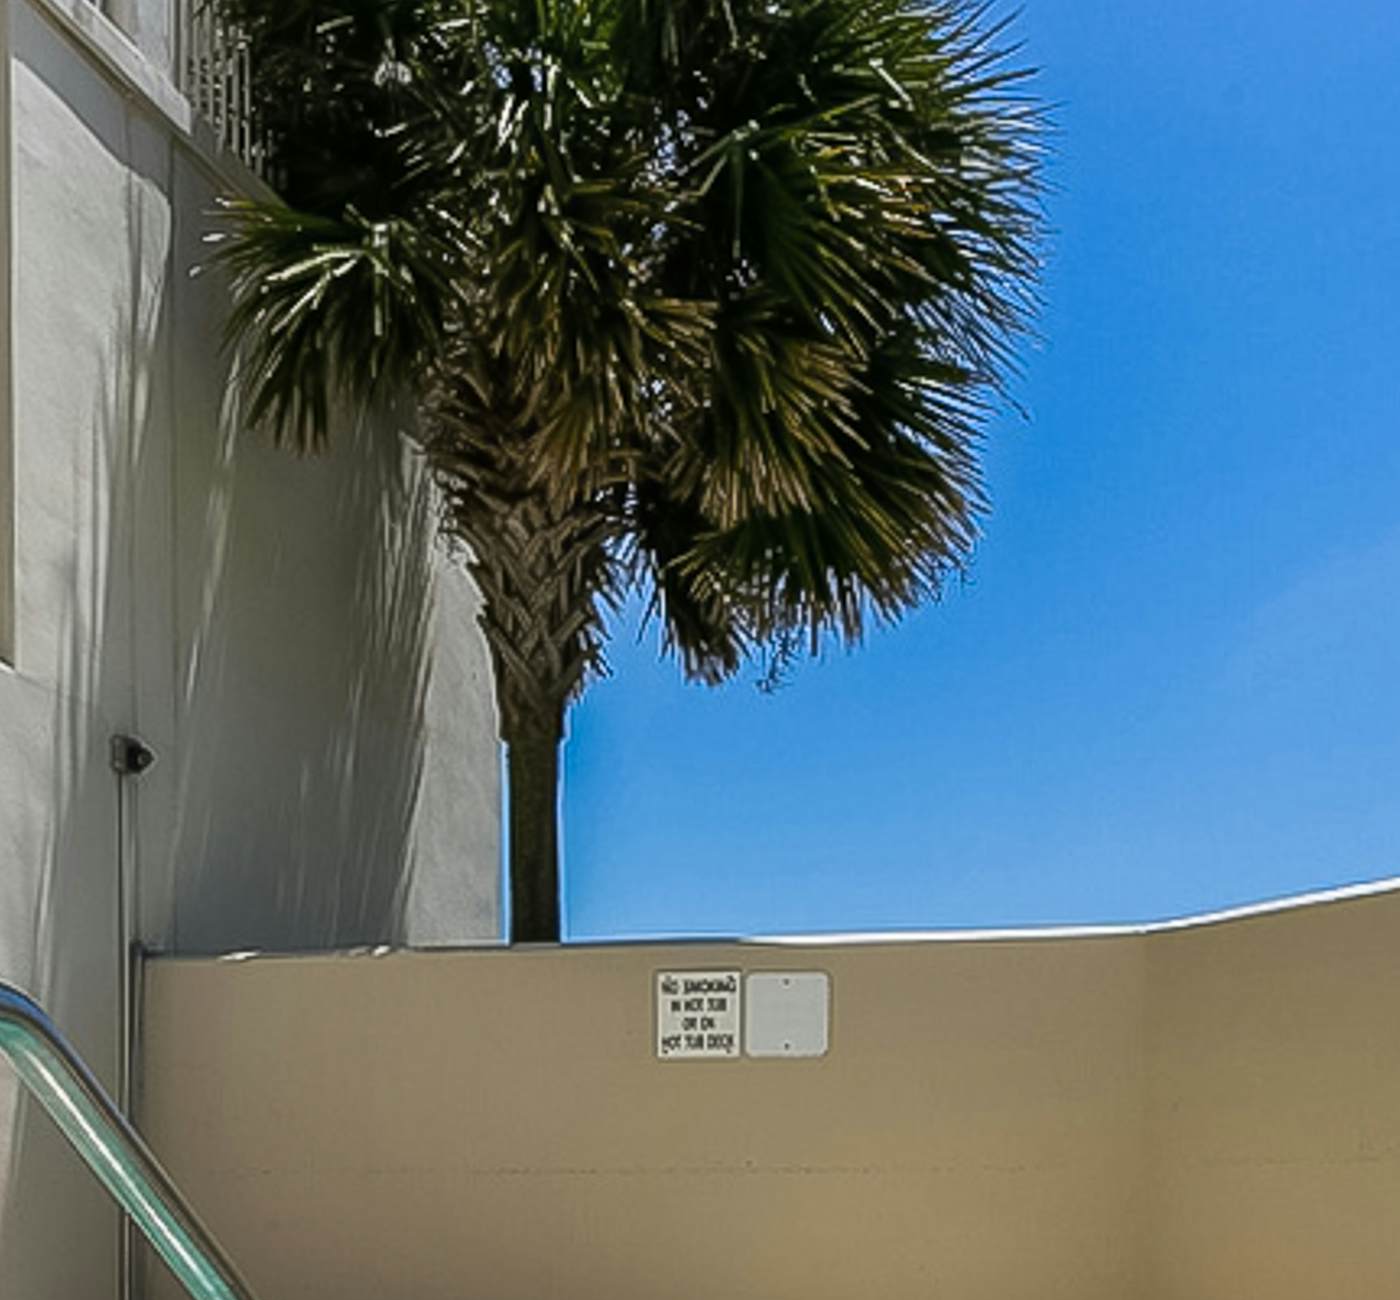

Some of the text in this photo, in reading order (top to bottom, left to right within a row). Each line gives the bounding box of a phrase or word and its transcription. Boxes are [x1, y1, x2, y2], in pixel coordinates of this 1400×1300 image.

[662, 980, 737, 995] NO SMOKING
[671, 998, 727, 1011] IN HOT TUB
[662, 1035, 681, 1049] HOT
[685, 1035, 704, 1049] TUB
